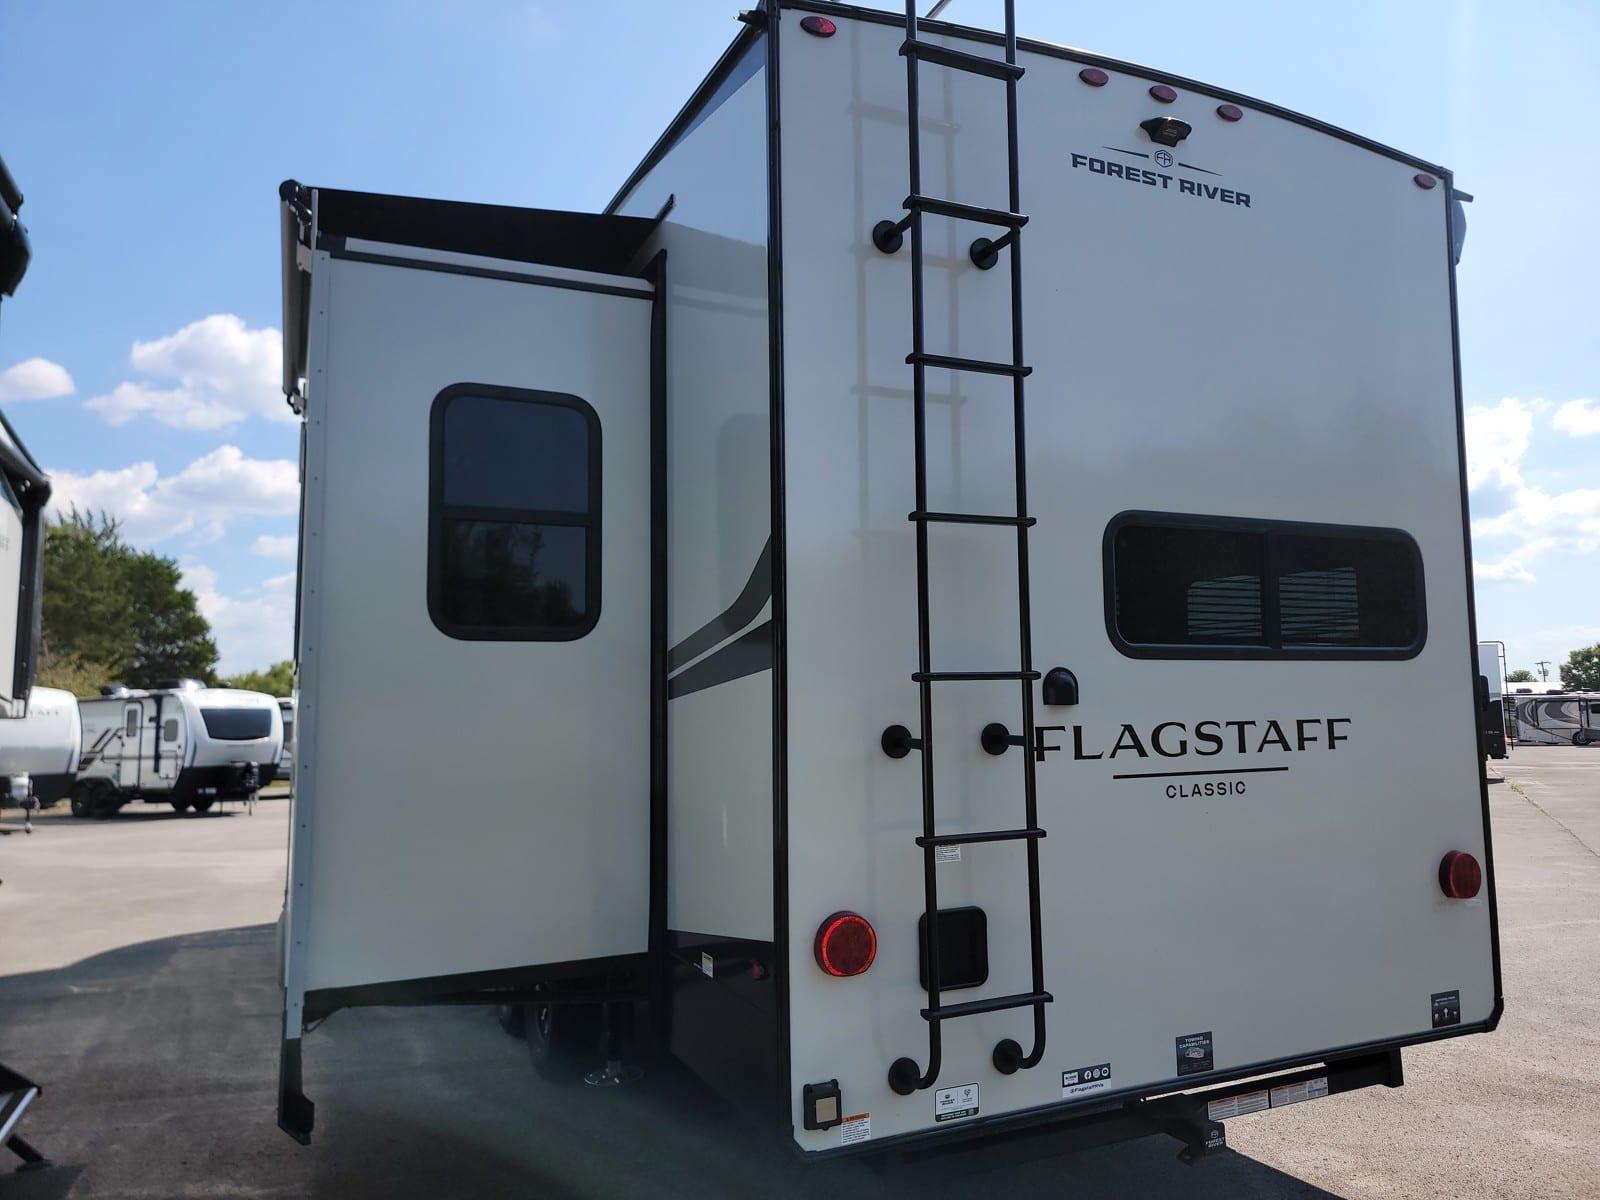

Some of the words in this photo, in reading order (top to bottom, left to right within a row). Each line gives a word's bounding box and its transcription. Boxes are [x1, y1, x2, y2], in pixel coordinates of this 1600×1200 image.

[1070, 152, 1173, 189] FOREST
[1178, 178, 1251, 208] RIVER
[1034, 718, 1351, 762] FLAGSTAFF
[1166, 781, 1246, 799] CLASSIC
